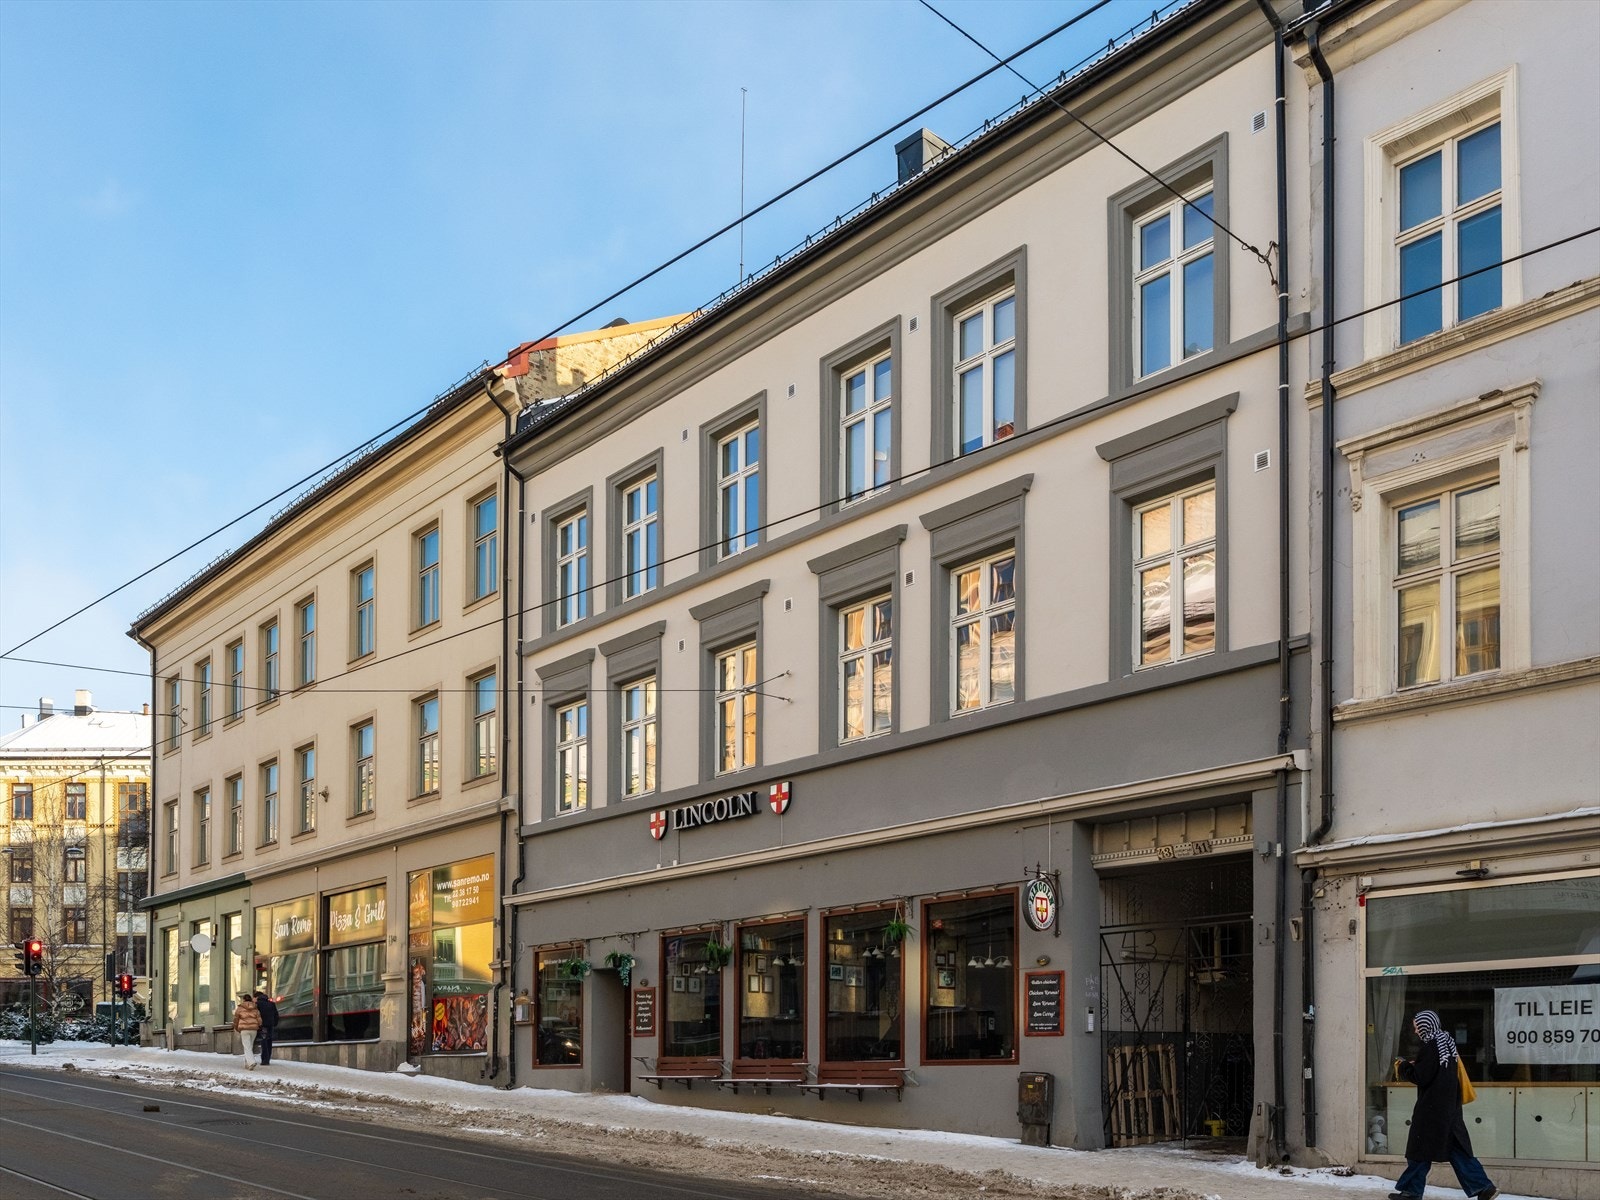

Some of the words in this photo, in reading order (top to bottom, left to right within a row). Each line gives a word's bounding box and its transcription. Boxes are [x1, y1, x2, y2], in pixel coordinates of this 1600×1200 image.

[672, 791, 754, 830] LINCOLN
[1158, 847, 1172, 859] 43
[1195, 842, 1208, 854] 41
[436, 873, 490, 890] www.sanremo.no
[466, 887, 472, 895] 17
[1029, 881, 1055, 906] LINCOLN
[452, 896, 480, 908] 90722941
[330, 911, 353, 932] Pizza
[364, 900, 386, 925] Grill
[273, 918, 290, 940] San
[291, 915, 313, 936] Remo
[1514, 1001, 1544, 1017] TIL
[1549, 999, 1593, 1016] LEIE
[1507, 1030, 1538, 1044] 900
[1542, 1029, 1575, 1044] 859
